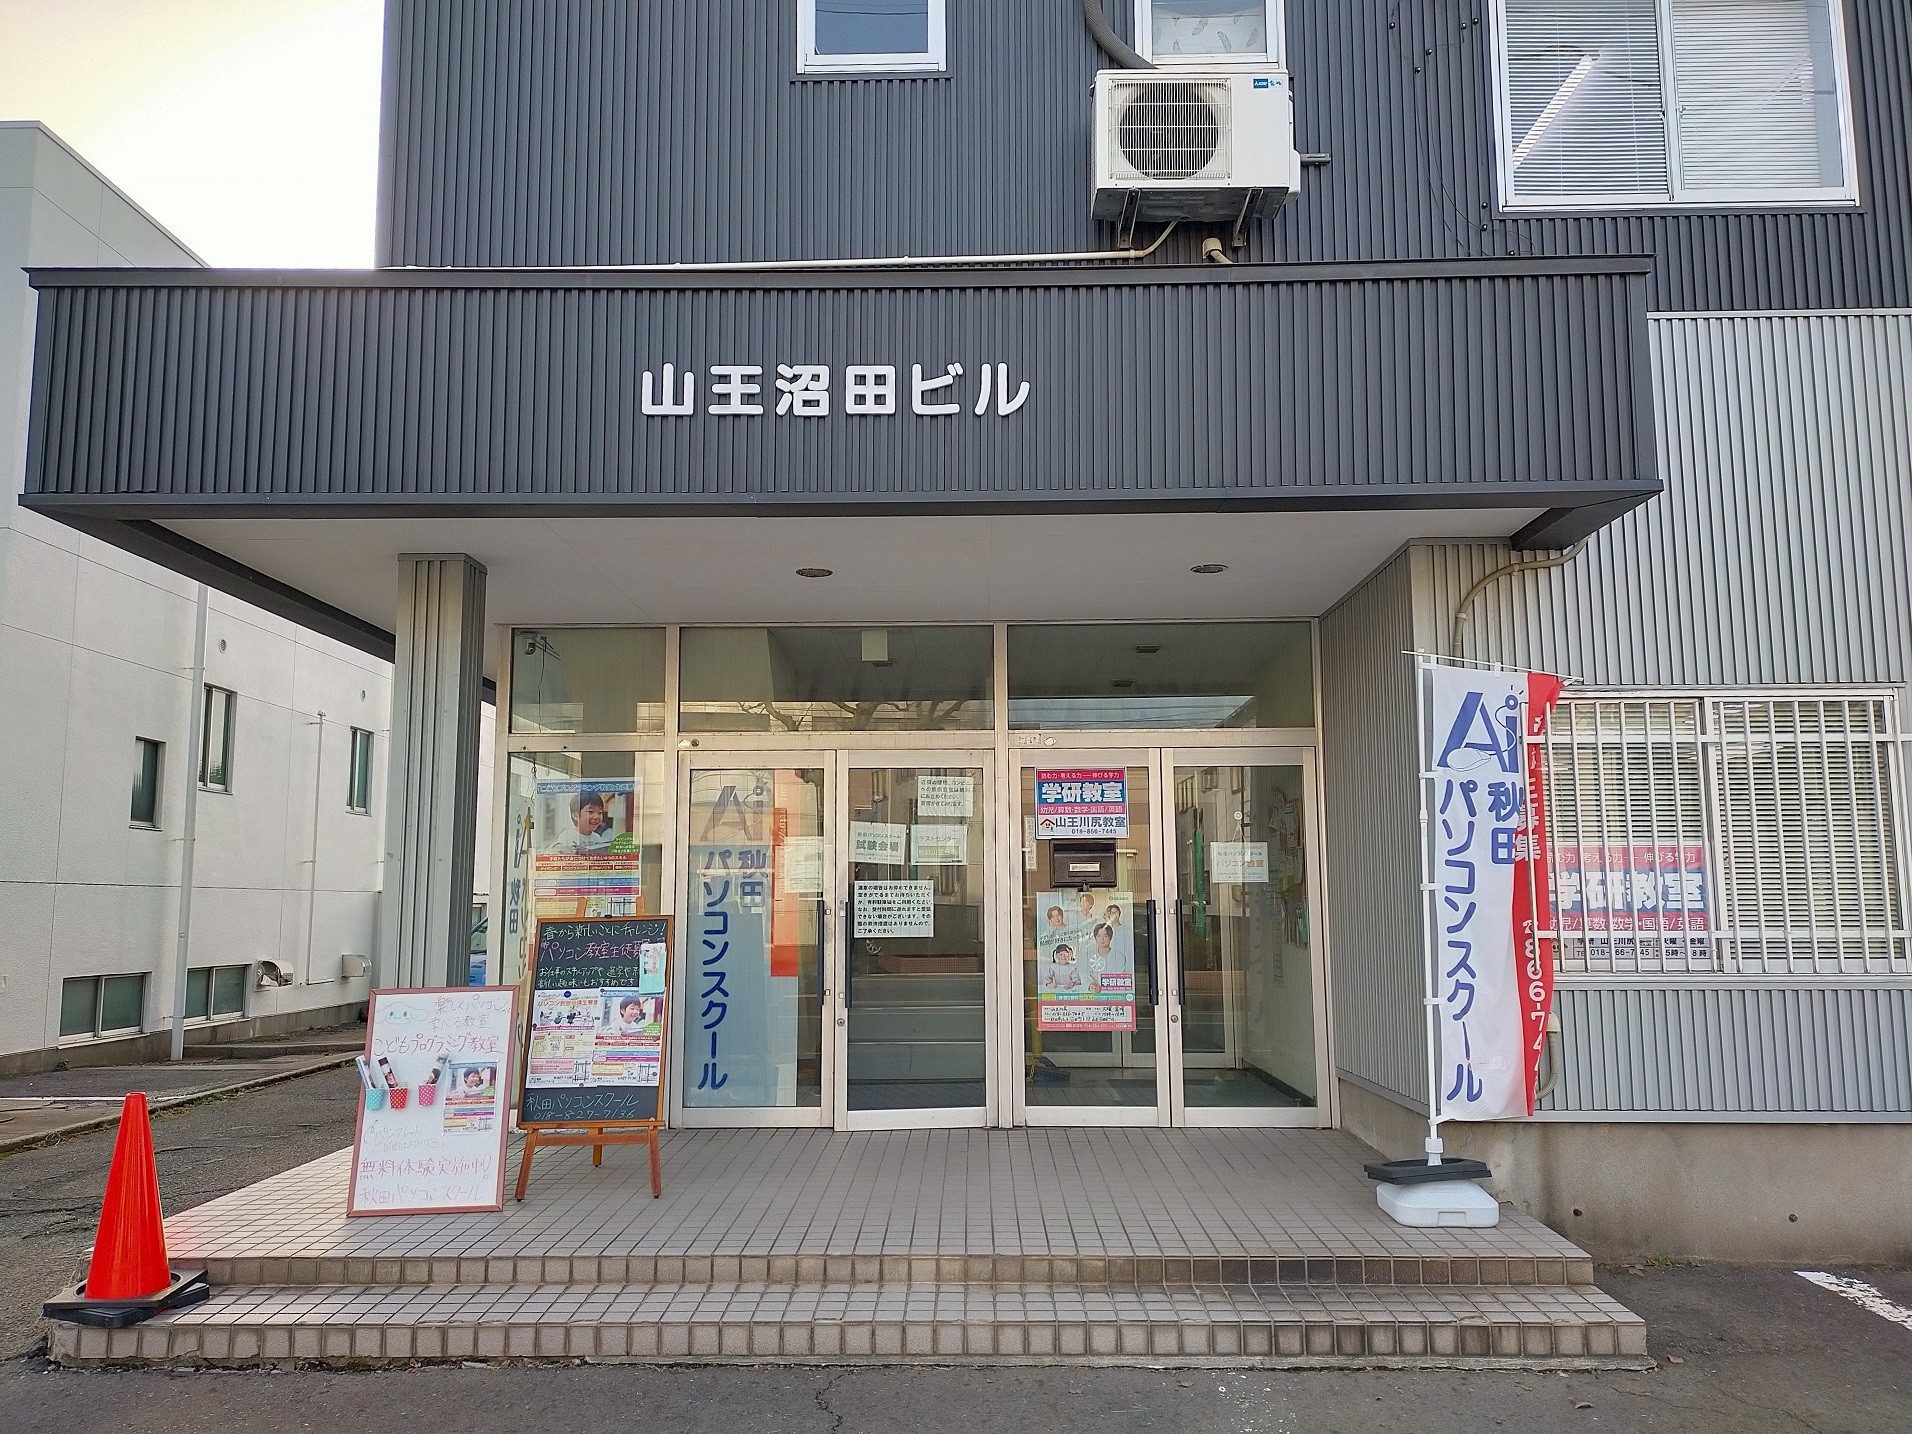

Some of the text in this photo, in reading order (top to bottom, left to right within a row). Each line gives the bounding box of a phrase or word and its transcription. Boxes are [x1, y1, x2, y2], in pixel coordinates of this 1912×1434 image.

[641, 362, 1031, 417] 山王沼田ビル
[1042, 781, 1123, 803] 学研教室
[1055, 816, 1126, 828] 山王川尻教室
[1487, 781, 1524, 865] 秋田
[856, 840, 899, 852] 試験会場
[1548, 870, 1704, 909] 学研教室
[1439, 779, 1483, 1103] パソコンスクール
[698, 849, 732, 1090] パソコンスクール
[374, 1033, 503, 1056] こどもプログラミング教室
[527, 1093, 639, 1111] 秋田パソコンスクール
